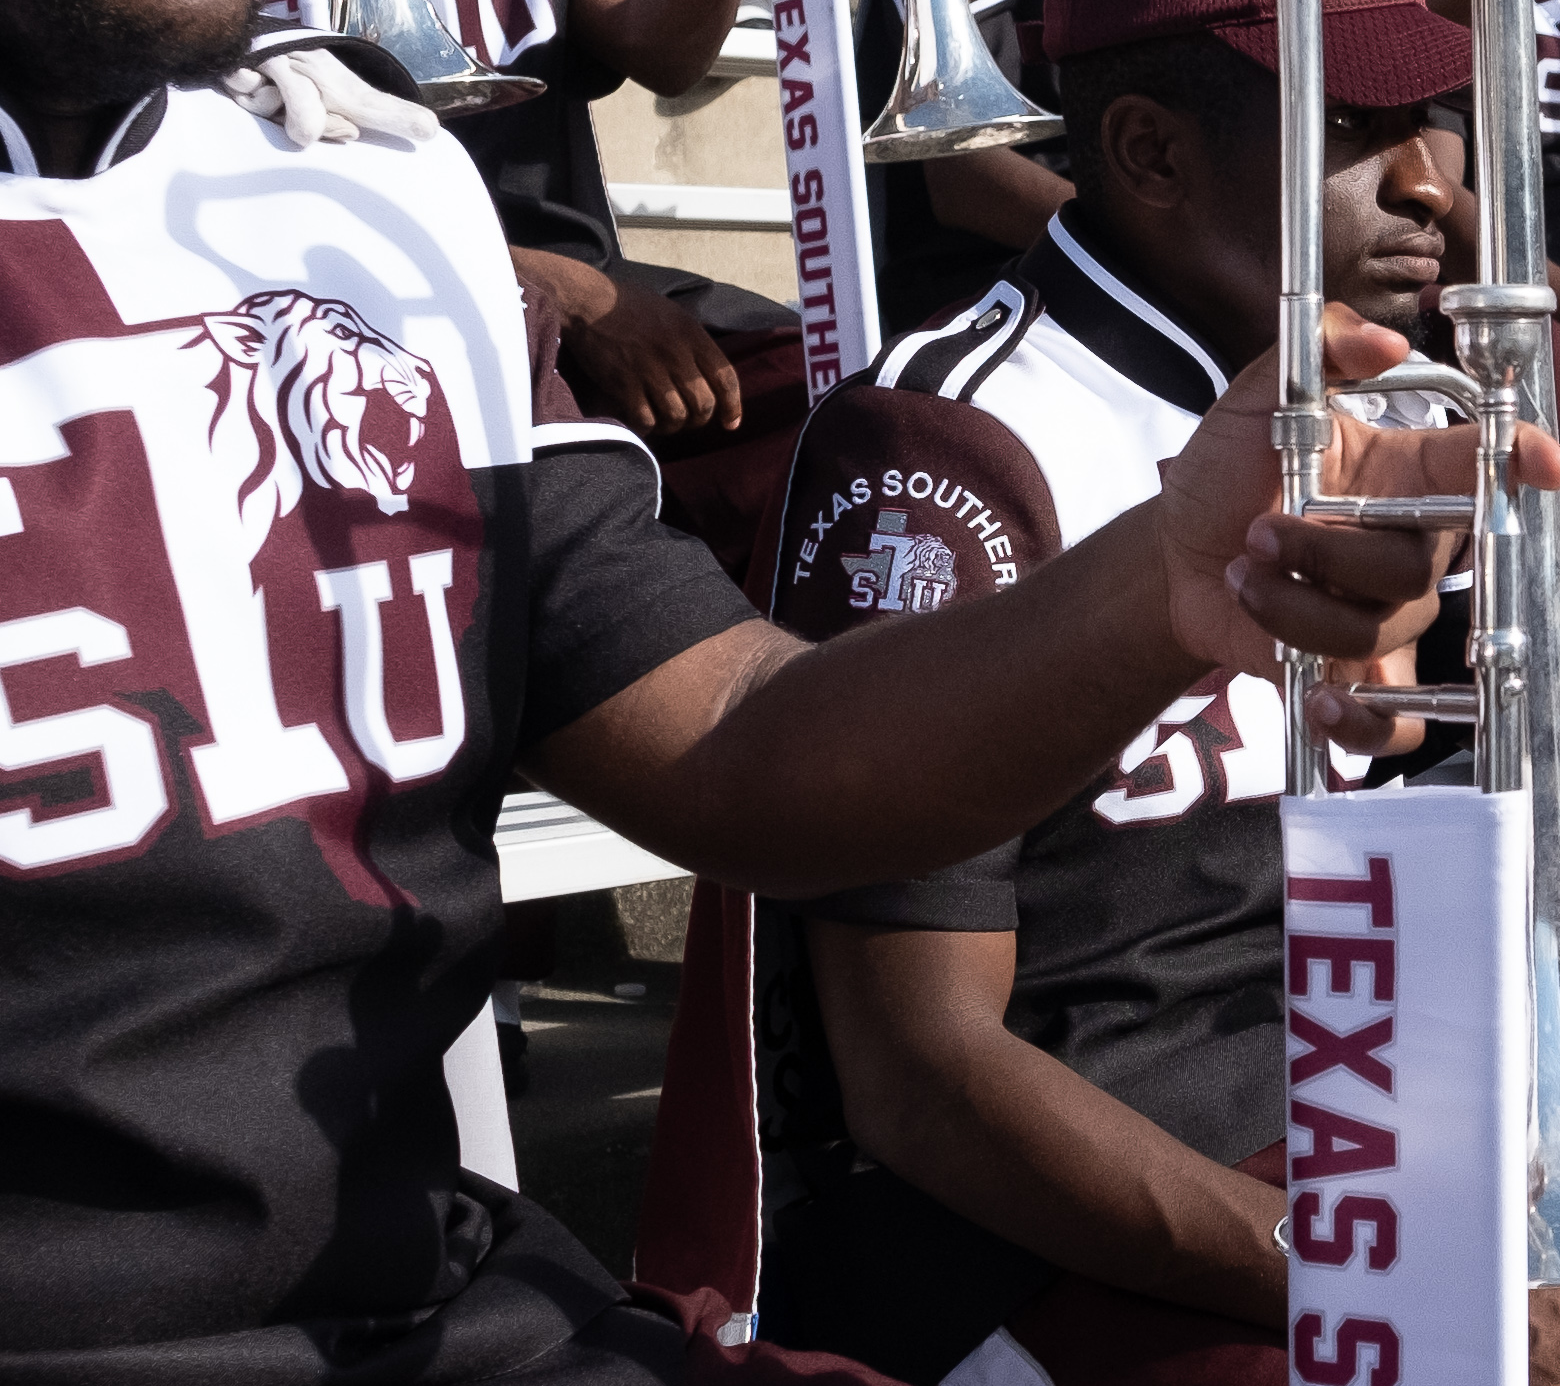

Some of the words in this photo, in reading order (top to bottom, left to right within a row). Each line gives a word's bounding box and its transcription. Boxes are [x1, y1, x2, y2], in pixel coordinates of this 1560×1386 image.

[788, 168, 842, 405] SOUTHE
[794, 478, 872, 585] TEXAS
[881, 469, 1018, 593] SOUTHER
[1285, 851, 1402, 1276] TEXAS
